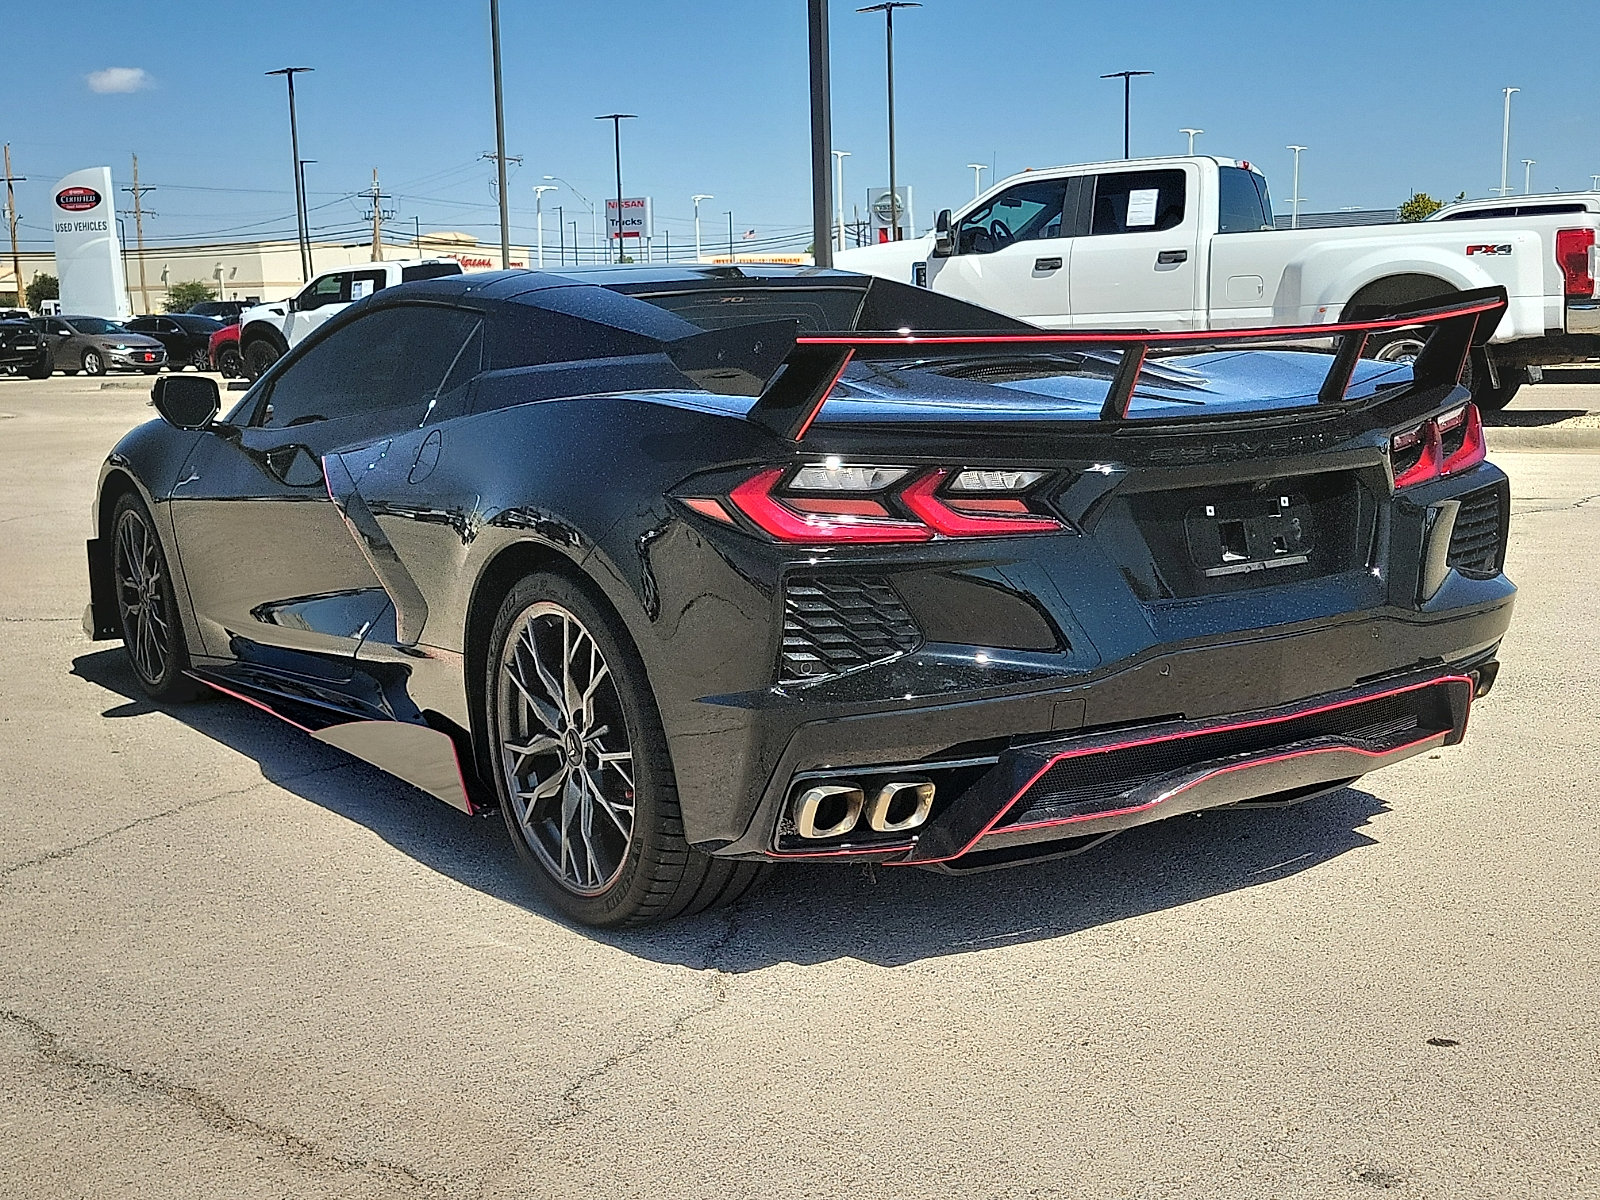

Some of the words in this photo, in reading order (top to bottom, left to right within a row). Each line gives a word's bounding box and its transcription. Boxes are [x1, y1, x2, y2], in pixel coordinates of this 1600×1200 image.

[55, 222, 73, 233] USED
[73, 221, 108, 232] VEHICLES
[1466, 244, 1513, 256] FX4
